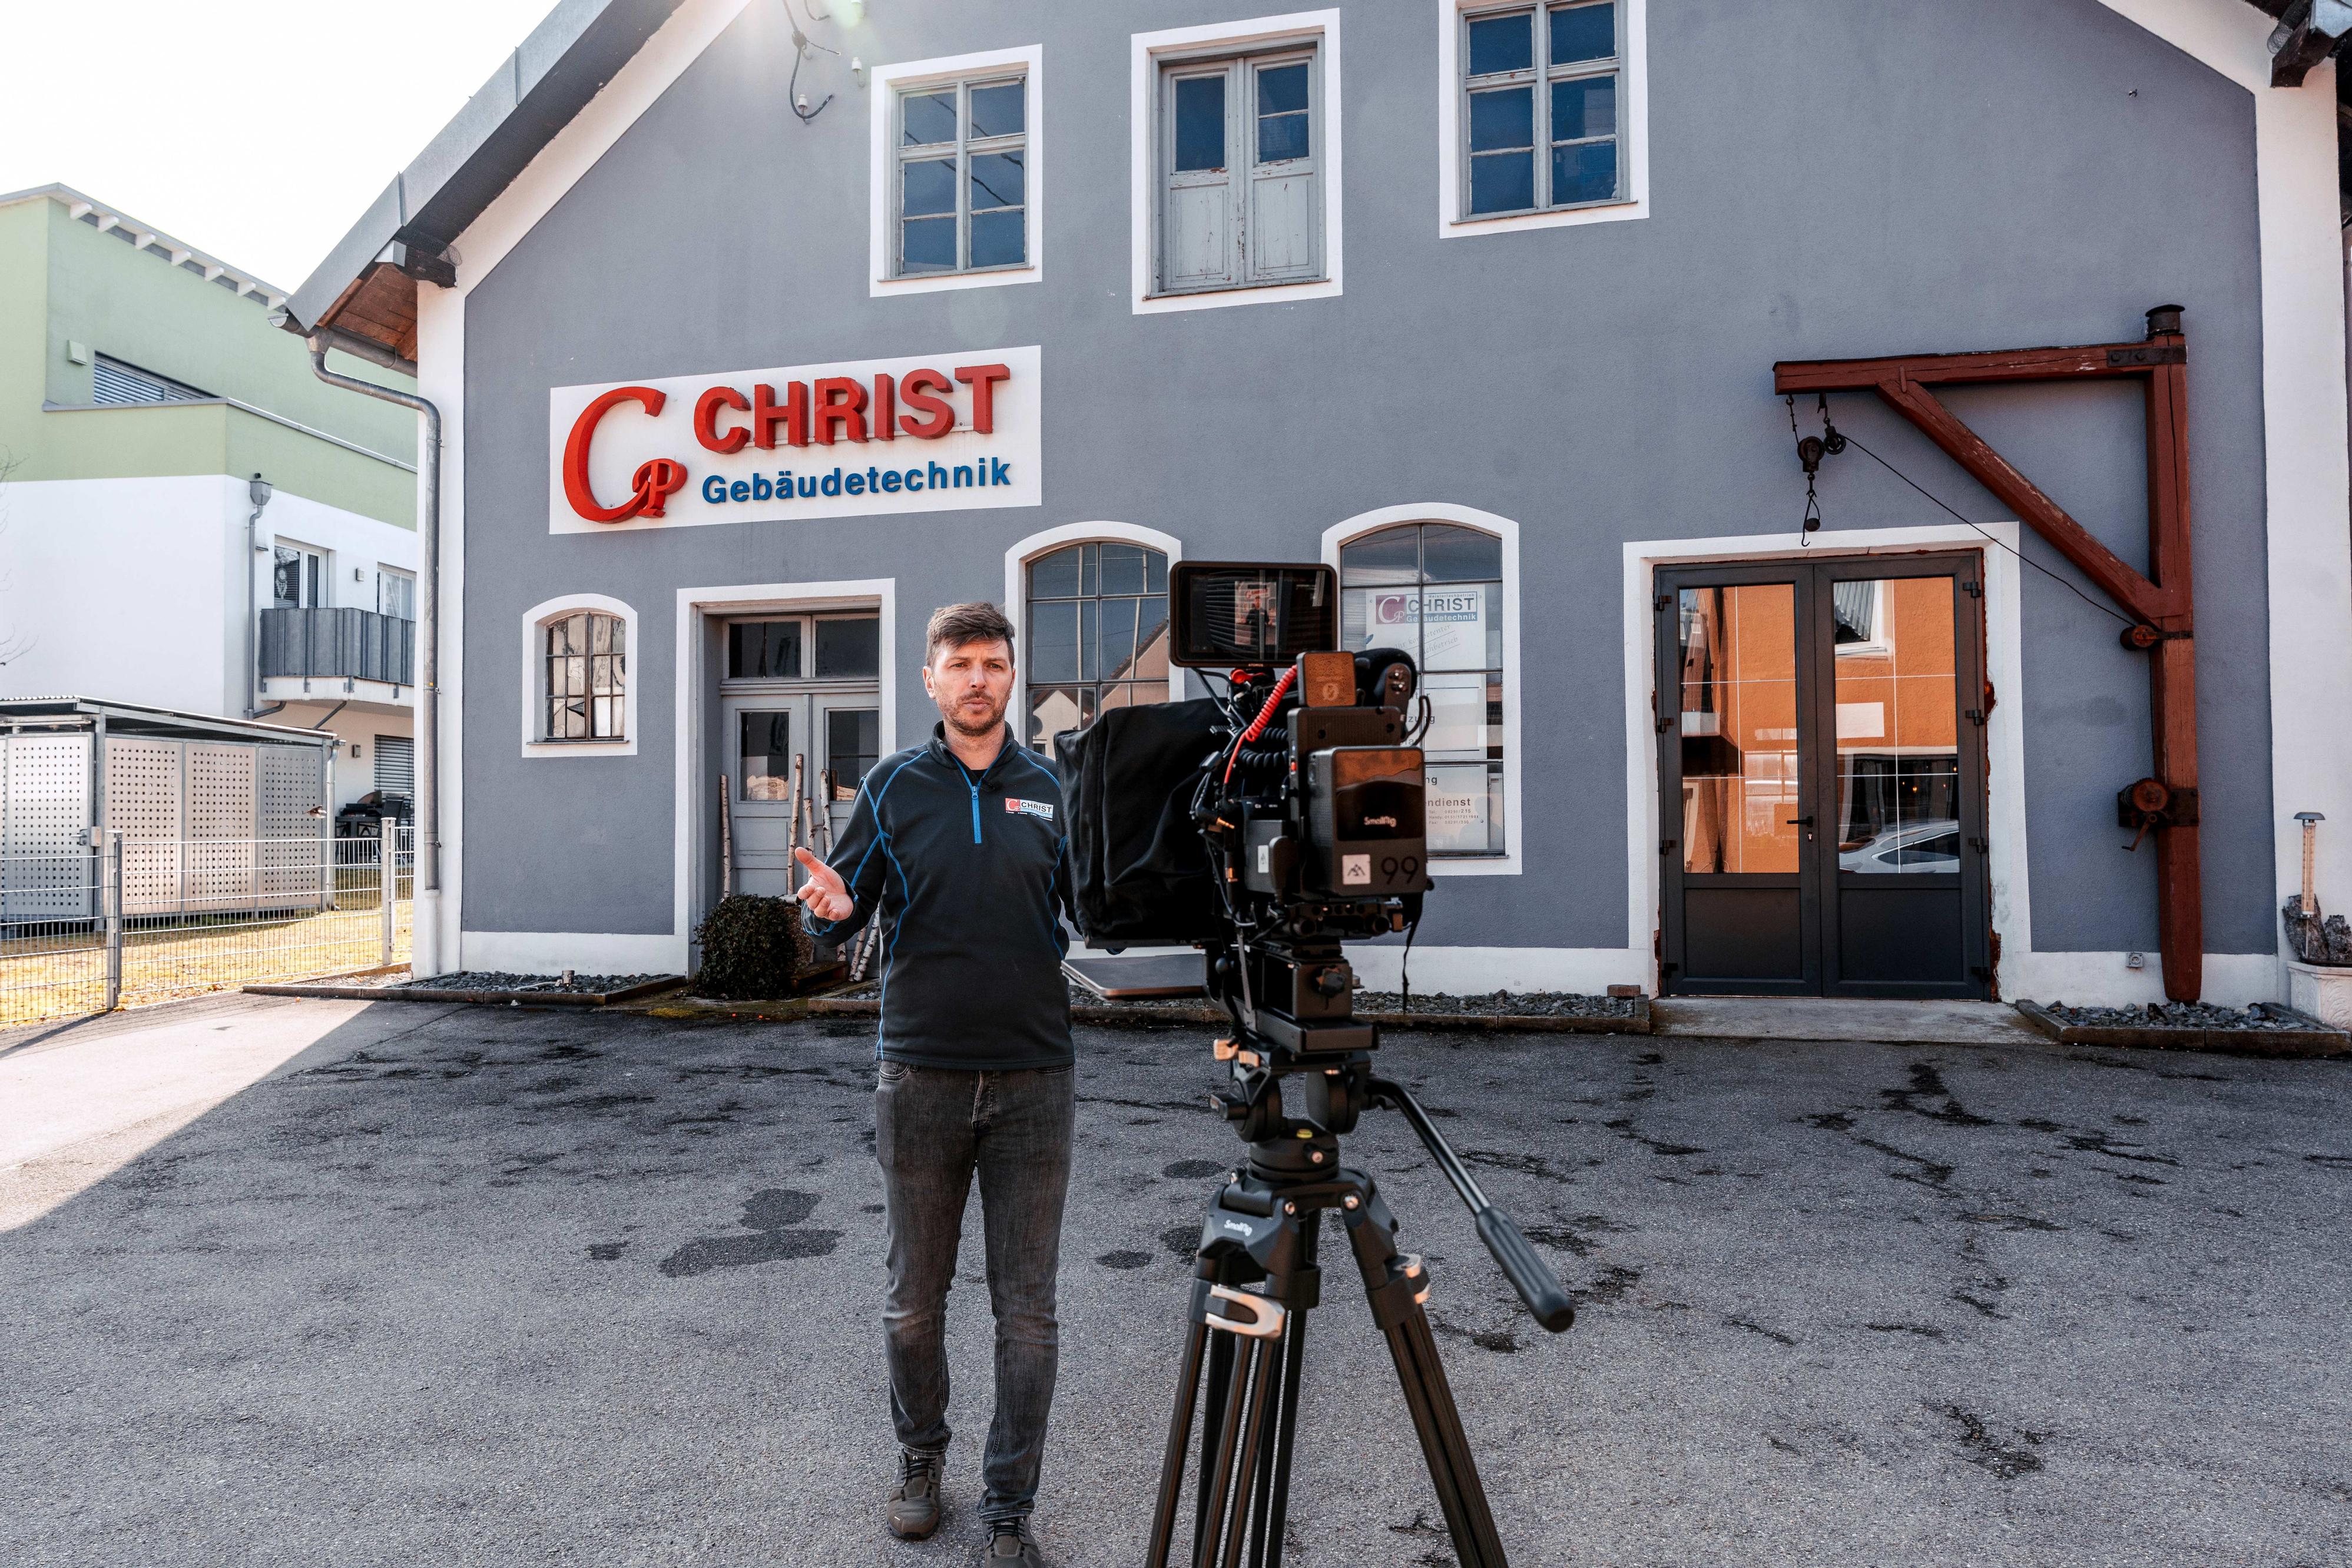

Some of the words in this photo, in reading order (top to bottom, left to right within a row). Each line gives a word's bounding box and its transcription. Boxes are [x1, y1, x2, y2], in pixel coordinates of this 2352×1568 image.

[694, 363, 1011, 455] CHRIST
[702, 457, 1011, 504] Gebäudetechnik
[1408, 598, 1474, 612] CHRIST
[1406, 614, 1476, 622] Geäudetechnik
[1021, 802, 1052, 813] CHRIST
[1425, 798, 1470, 806] ndienst
[1364, 816, 1396, 827] SmallRig
[1382, 857, 1418, 884] 99
